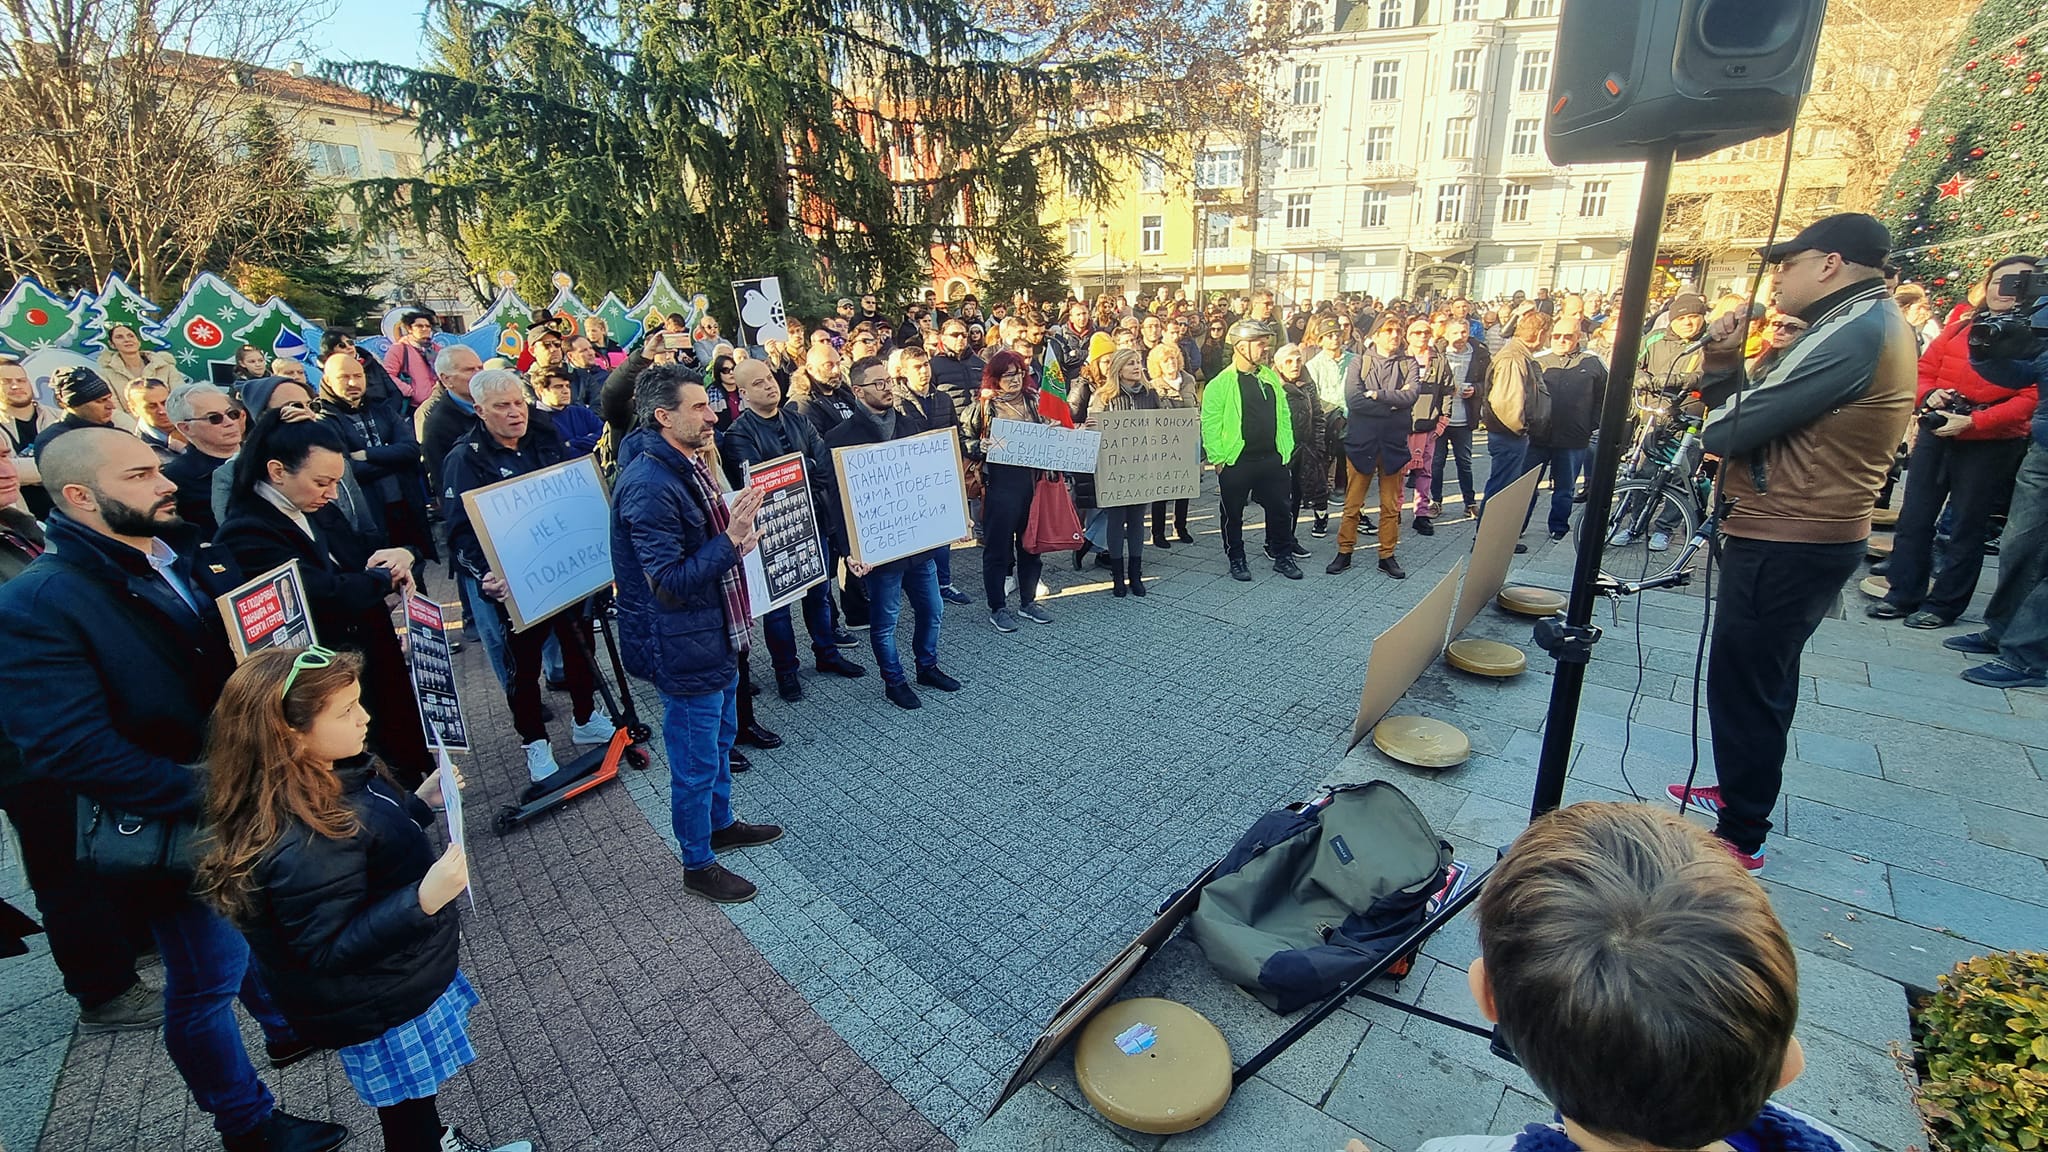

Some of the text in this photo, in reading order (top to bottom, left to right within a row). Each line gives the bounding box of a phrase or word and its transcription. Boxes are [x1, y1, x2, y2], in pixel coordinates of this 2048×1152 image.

[1103, 416, 1194, 430] РУСКИЯ КОНСУЛ
[1076, 431, 1088, 445] НЕ
[1102, 434, 1180, 450] ЗАГРАБВА
[847, 439, 950, 472] КОЙТО ПРЕДАДЕ
[1002, 454, 1014, 463] НИ
[1108, 451, 1182, 466] ПАНАИРА.
[850, 461, 912, 492] ПАНАИРА
[1108, 470, 1190, 484] ДЪРЖАВАТА
[490, 467, 590, 517] ПАНАИРА
[855, 469, 953, 509] НЯМА ПОВЕЧЕ
[1100, 488, 1141, 501] ГЛЕДА
[858, 494, 928, 525] МЯСТО В
[861, 503, 947, 538] ОБЩИНСКИЯ
[529, 513, 568, 545] НЕ Е
[864, 525, 918, 554] СЪВЕТ
[524, 542, 608, 593] ПОДАРЪК
[239, 600, 248, 614] ТЕ
[246, 620, 267, 640] ГЕОРГИ
